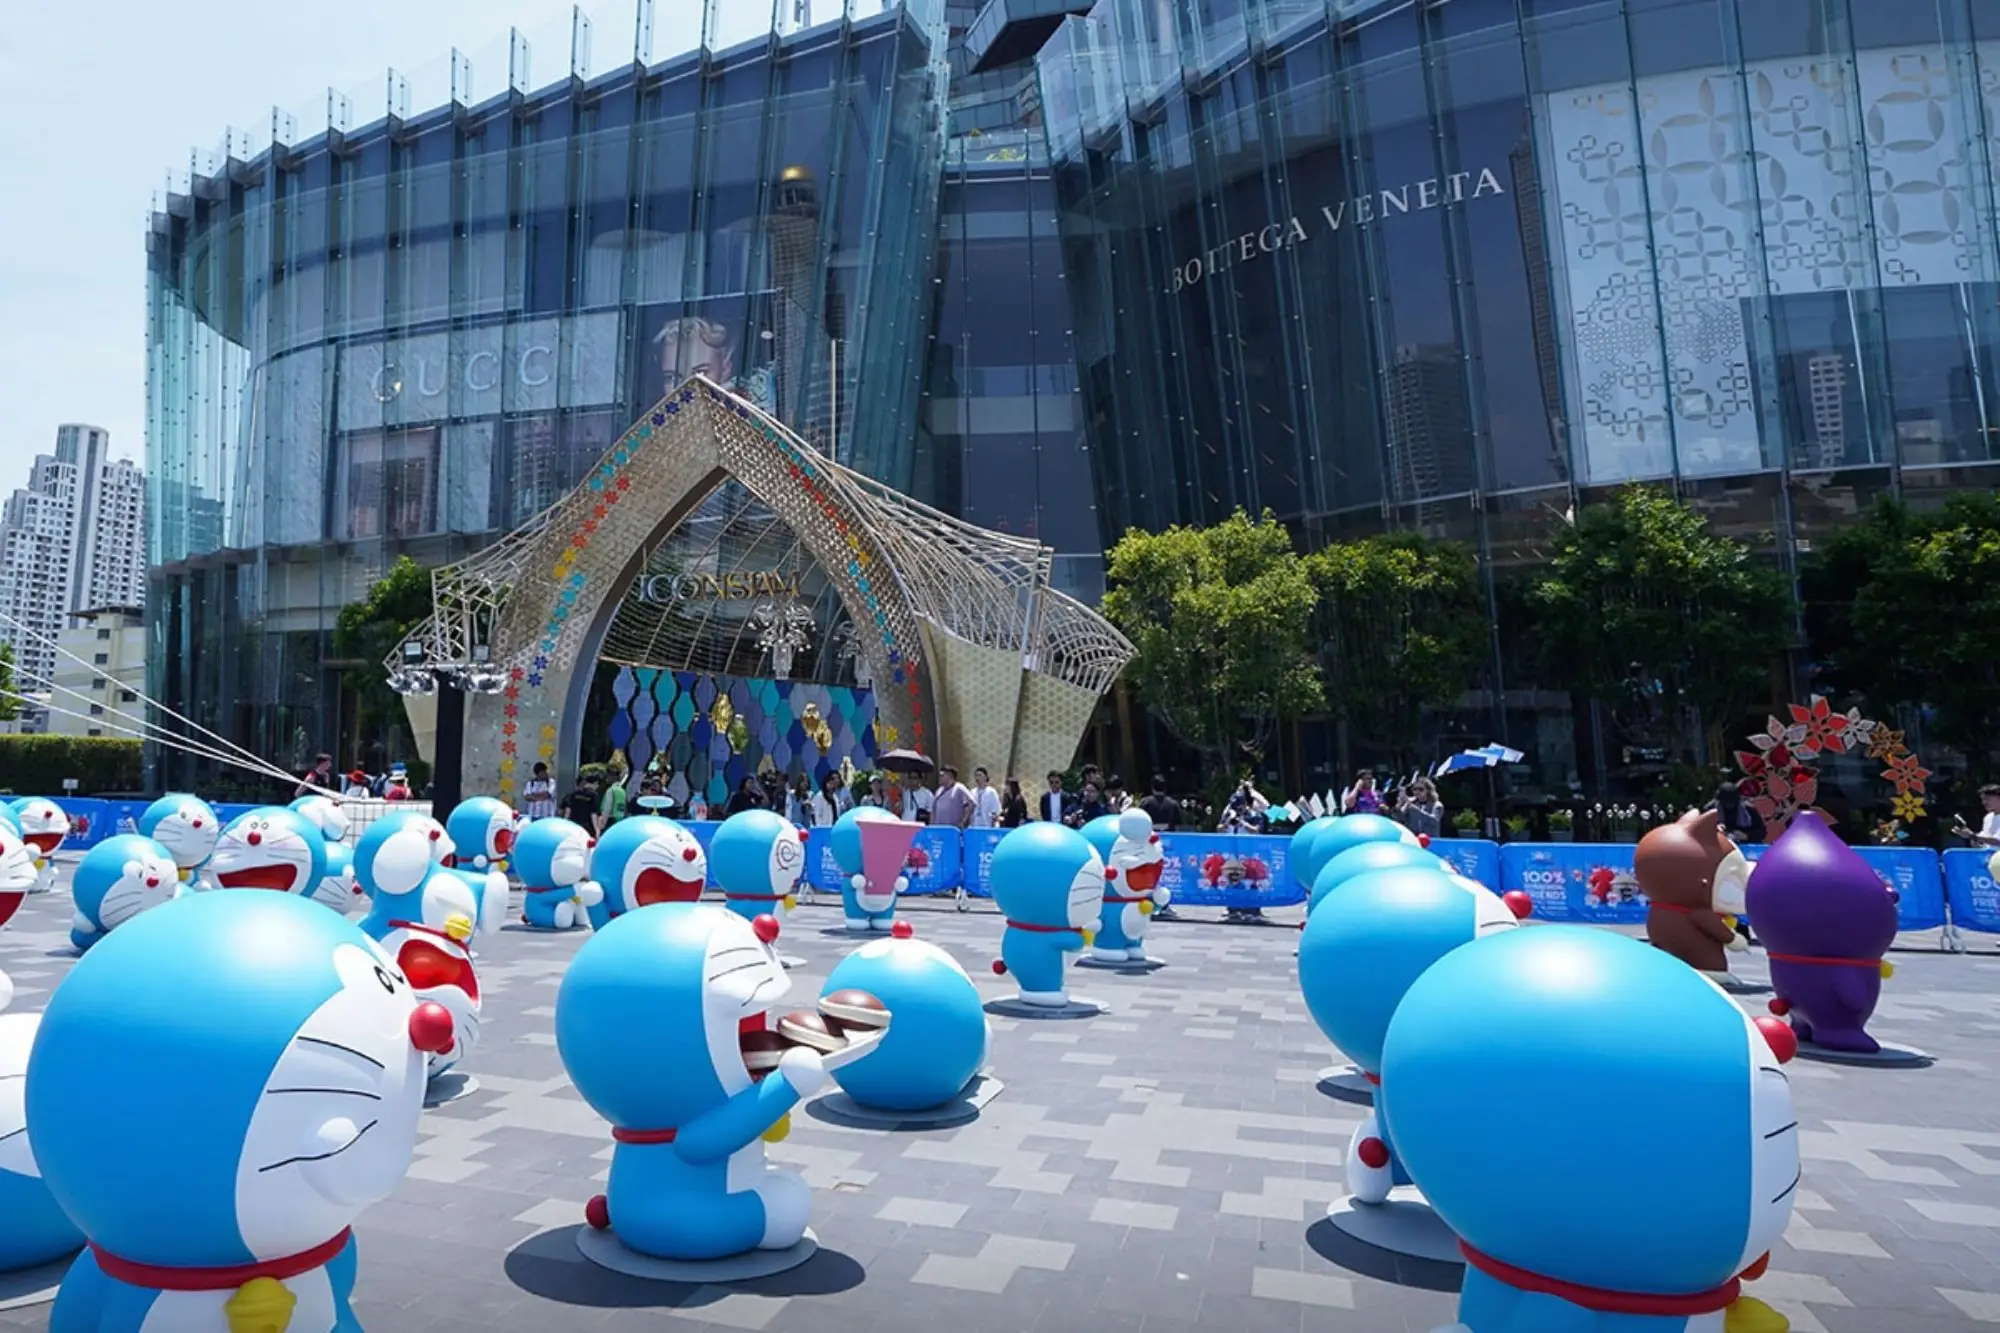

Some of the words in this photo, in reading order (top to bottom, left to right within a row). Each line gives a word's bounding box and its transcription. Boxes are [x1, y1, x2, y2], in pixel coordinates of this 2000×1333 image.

[1172, 216, 1308, 293] BOTTEGA
[1320, 167, 1505, 230] VENETA
[371, 341, 580, 402] GUCCI
[638, 570, 801, 602] ICONSIAM
[1522, 870, 1566, 885] 100%
